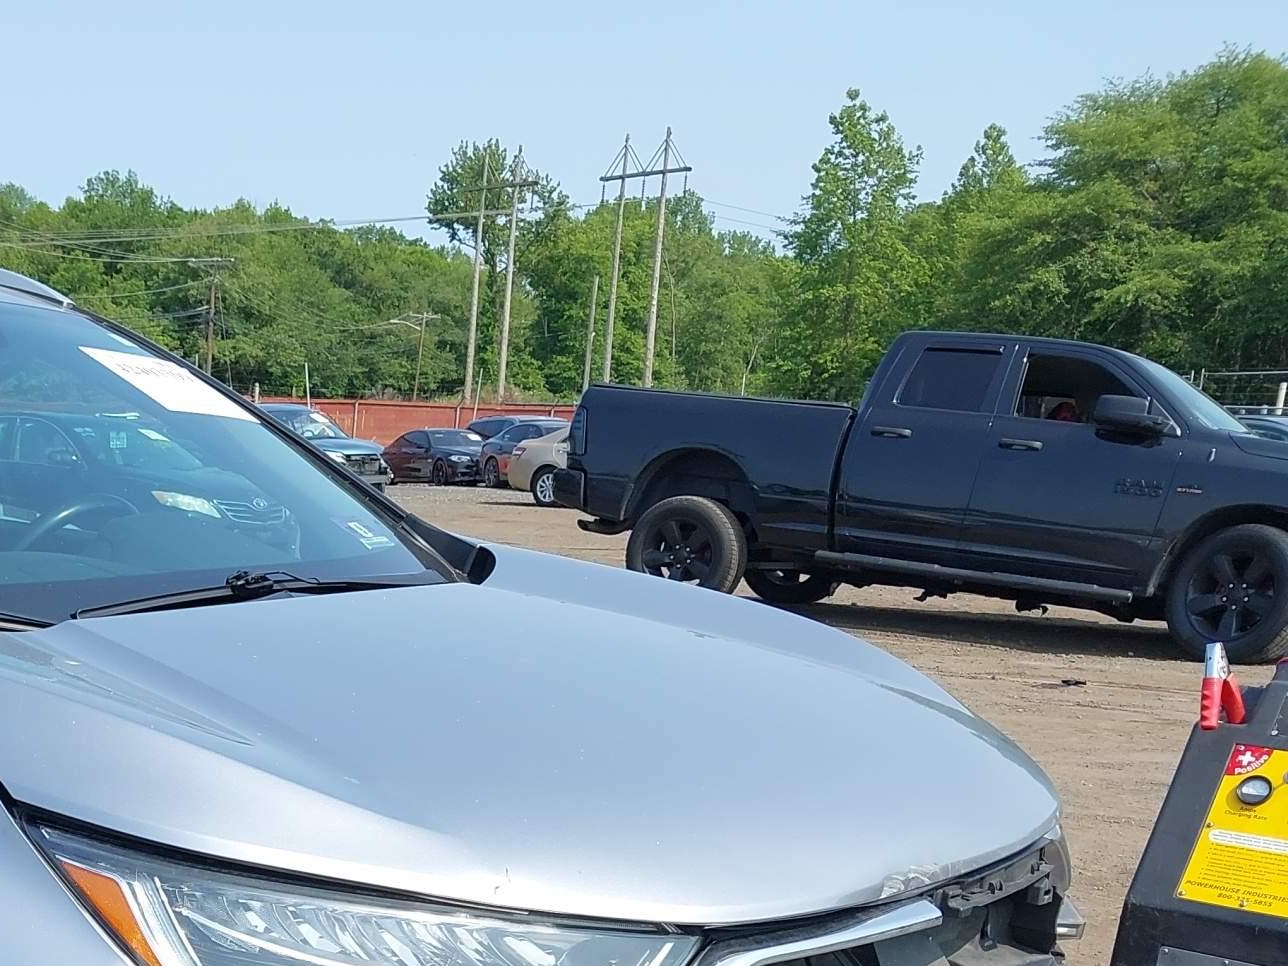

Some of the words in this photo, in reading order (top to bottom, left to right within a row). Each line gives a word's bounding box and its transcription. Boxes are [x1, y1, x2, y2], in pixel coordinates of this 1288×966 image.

[1234, 754, 1269, 775] Positive
[1224, 809, 1252, 819] Charging
[1184, 879, 1241, 894] POWERHOUSE
